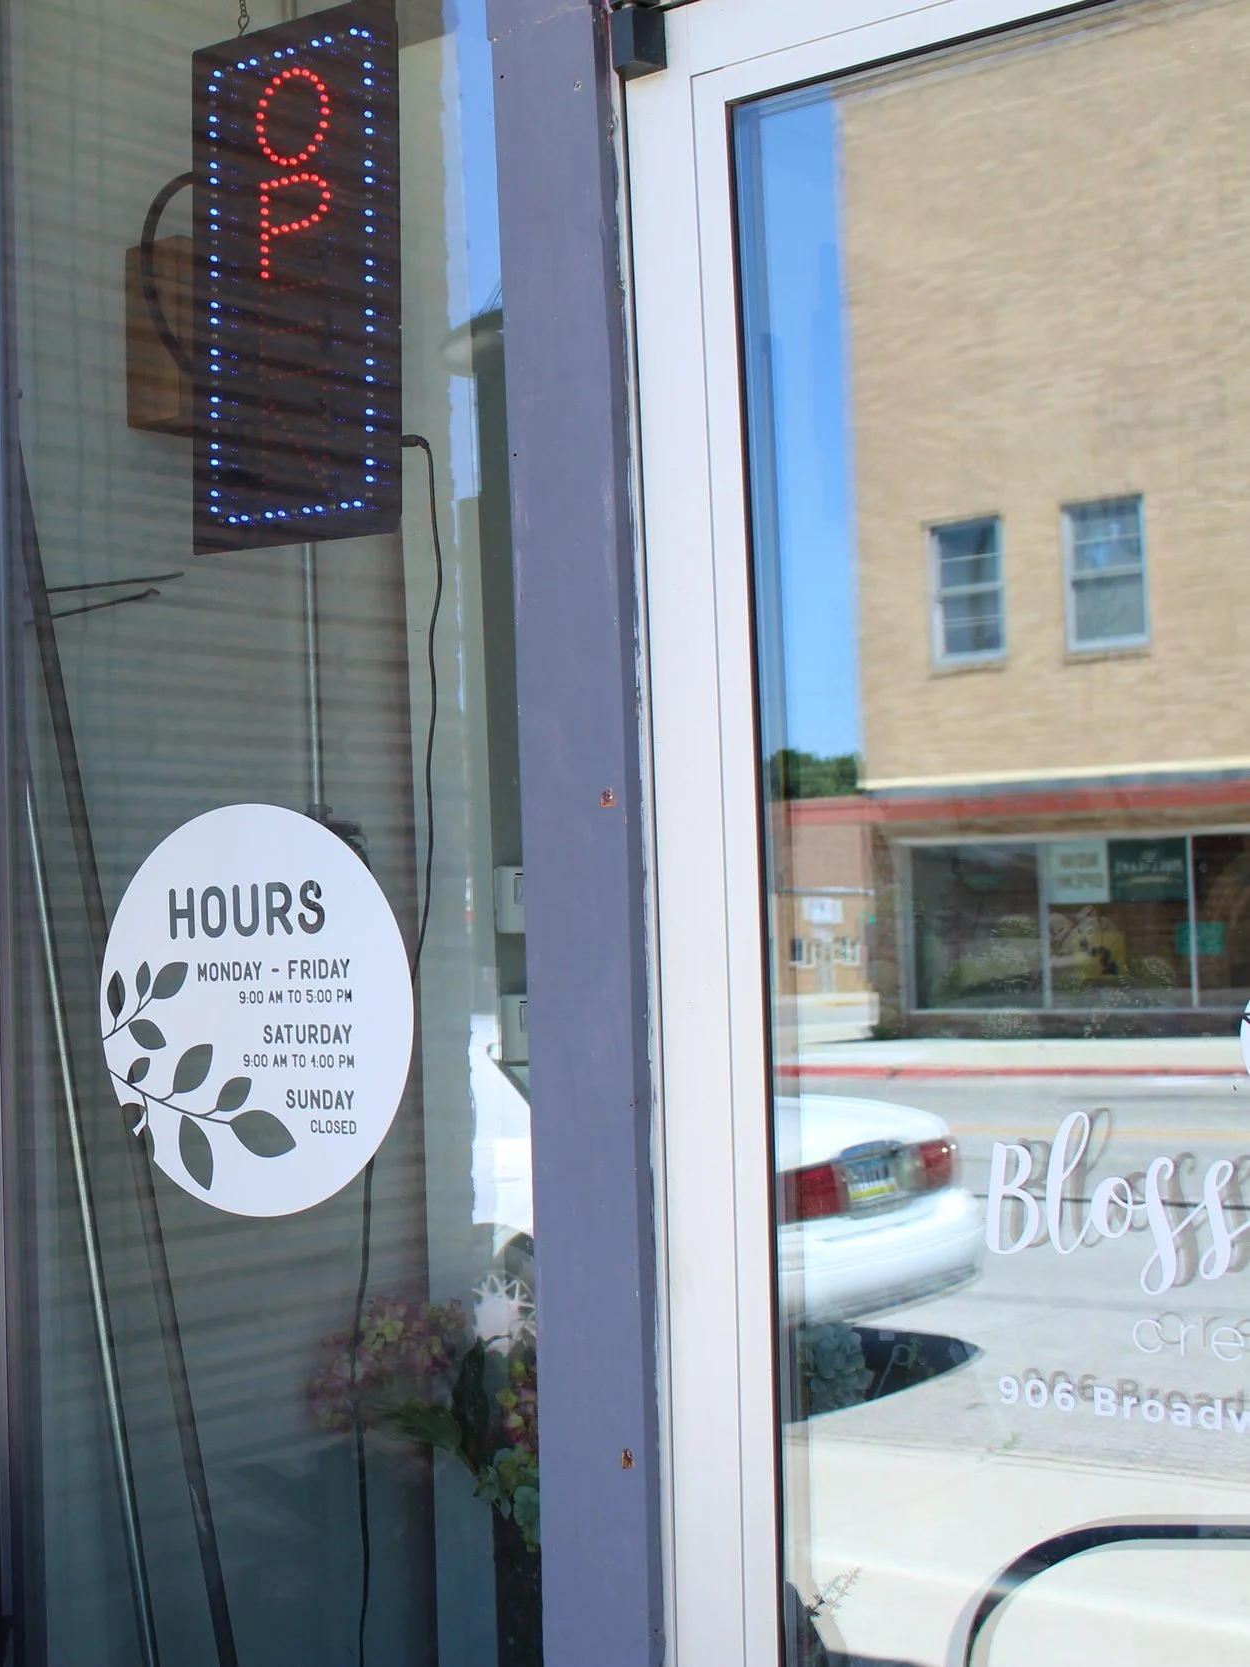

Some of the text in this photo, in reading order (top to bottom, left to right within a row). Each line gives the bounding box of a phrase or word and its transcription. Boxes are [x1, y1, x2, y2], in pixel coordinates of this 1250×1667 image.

[168, 879, 326, 940] HOURS
[197, 961, 263, 982] MONDAY
[287, 958, 351, 980] FRIDAY
[238, 988, 353, 1004] 9:00 AM TO 5:00 PM
[262, 1023, 353, 1045] SATURDAY
[242, 1053, 268, 1068] 9:00
[272, 1054, 288, 1068] AM
[291, 1054, 307, 1068] TO
[338, 1054, 355, 1069] PM
[285, 1088, 355, 1111] SUNDAY
[310, 1119, 357, 1135] CLOSED
[985, 1110, 1250, 1296] Bloss
[1132, 1318, 1246, 1362] cre
[997, 1375, 1076, 1412] 906
